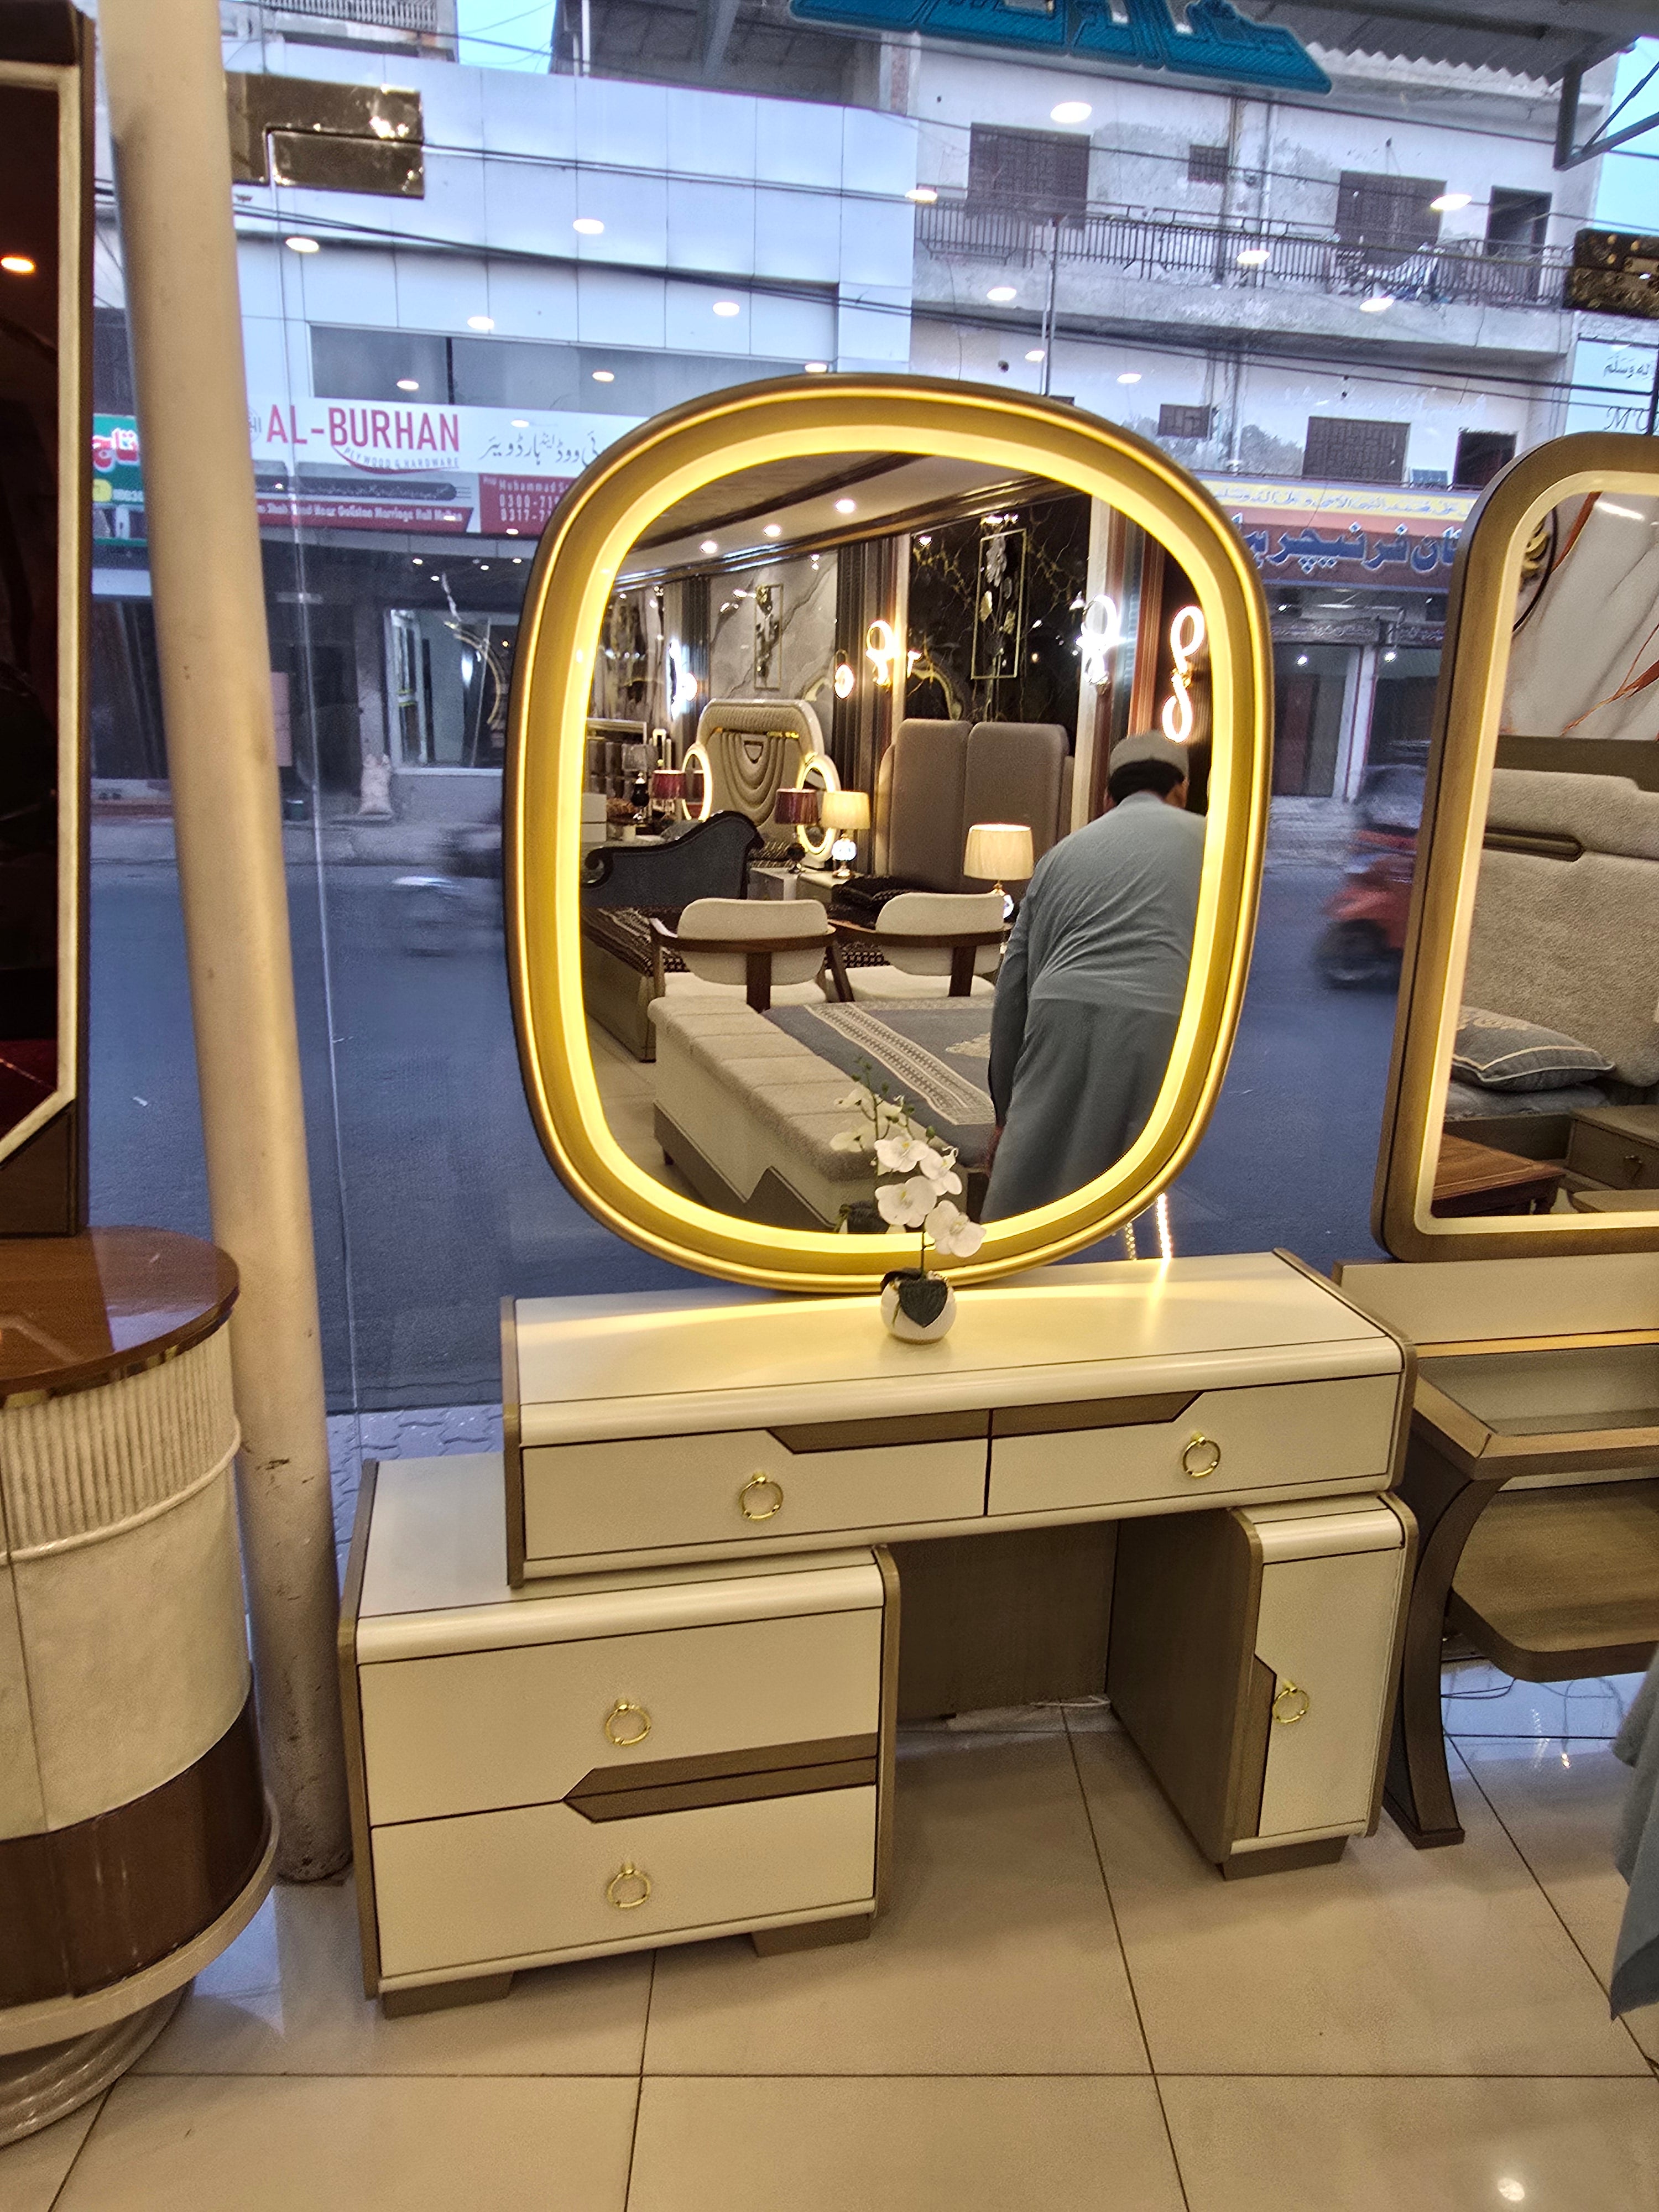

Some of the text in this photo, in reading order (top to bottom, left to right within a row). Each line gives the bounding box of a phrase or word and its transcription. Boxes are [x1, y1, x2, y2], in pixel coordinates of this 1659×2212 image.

[267, 404, 460, 452] AL-BURHAN
[343, 446, 391, 469] PLYWOOD
[404, 457, 460, 468] HARDWARE
